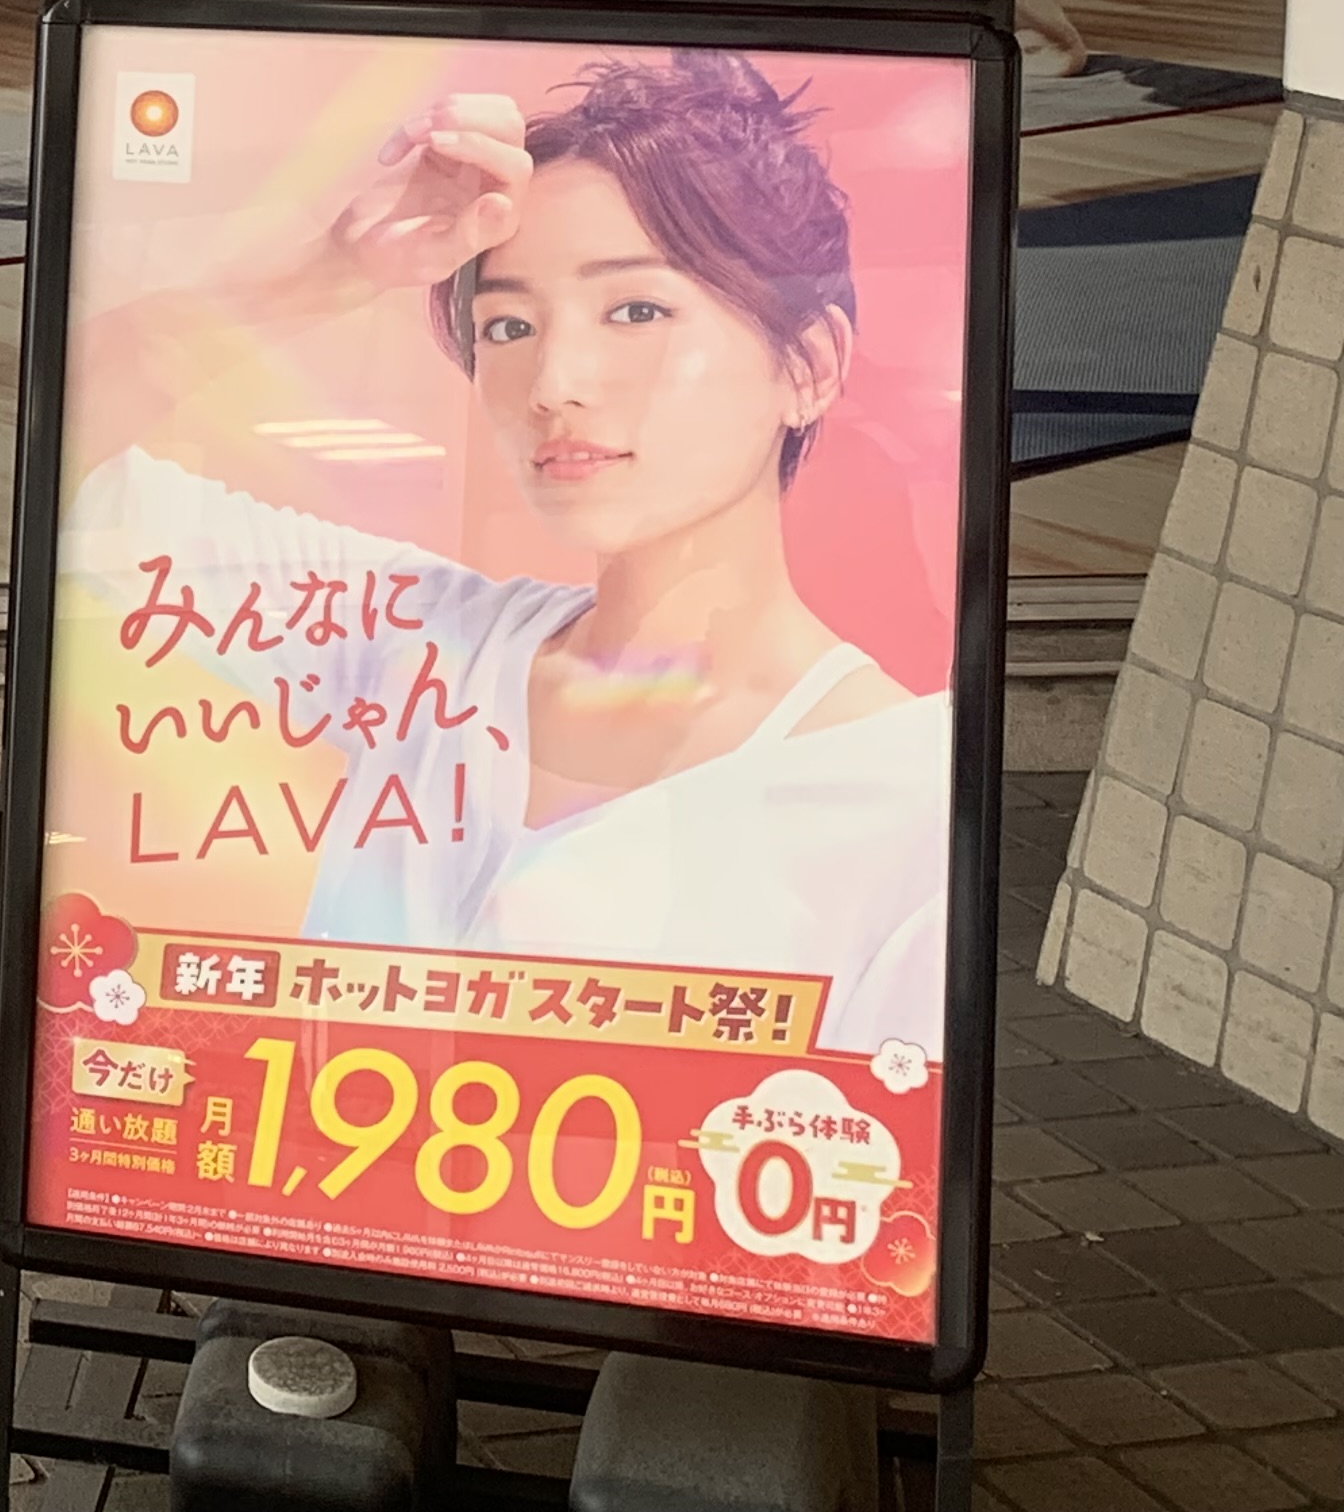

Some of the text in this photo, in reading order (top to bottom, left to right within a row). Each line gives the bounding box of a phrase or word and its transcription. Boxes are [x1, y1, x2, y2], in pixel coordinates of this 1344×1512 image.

[125, 142, 180, 157] LAVA
[120, 554, 424, 668] みんなに
[115, 641, 511, 754] いいじゃん、
[129, 762, 467, 865] LAVA!
[174, 951, 794, 1041] 新年 ホットヨガスタート祭!
[81, 1048, 174, 1094] 今だけ
[69, 1105, 179, 1145] 通い放題
[196, 1095, 238, 1184] 月額
[243, 1037, 695, 1245] 1,980 円
[732, 1105, 872, 1146] 手ぶら体験
